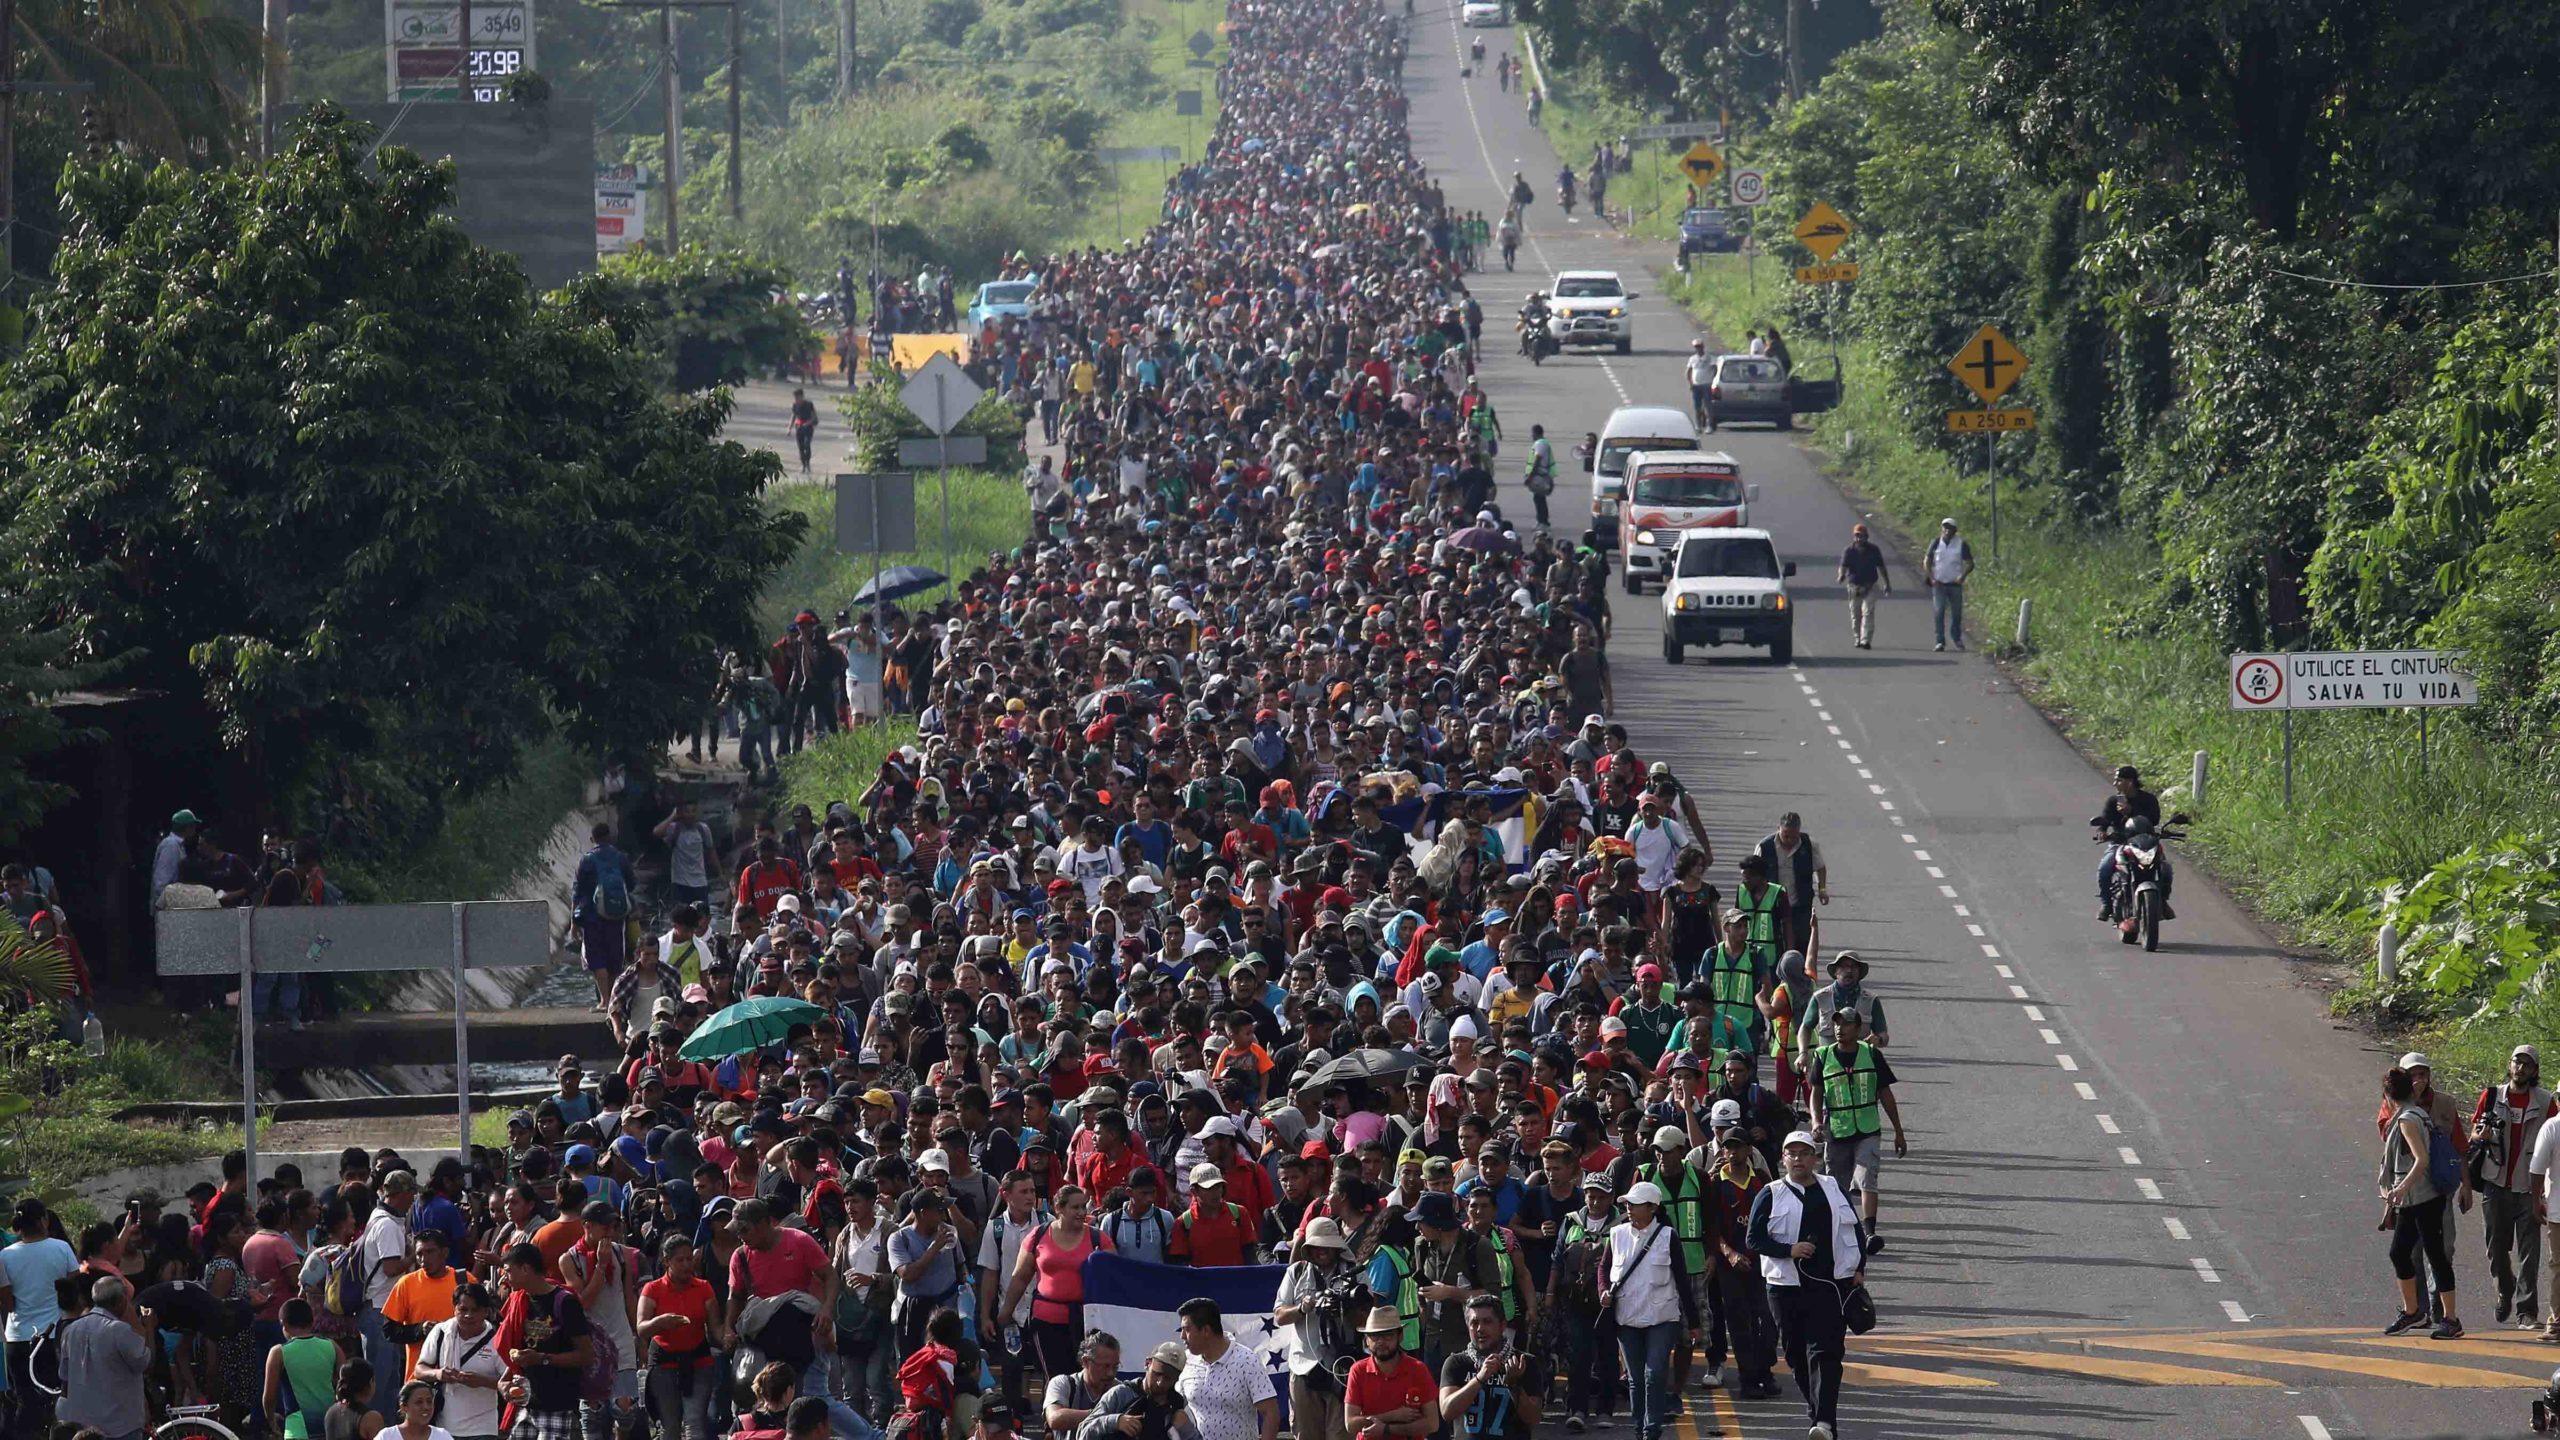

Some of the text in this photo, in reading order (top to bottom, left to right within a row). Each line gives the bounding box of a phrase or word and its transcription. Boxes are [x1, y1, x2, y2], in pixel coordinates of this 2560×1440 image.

[485, 15, 521, 32] 3549
[1740, 180, 1758, 192] 40
[606, 198, 628, 208] VISA
[1804, 270, 1811, 280] A
[1958, 413, 2026, 428] A 250 m
[2295, 657, 2473, 677] UTILICE EL CINTURO
[2307, 682, 2461, 701] SALVA TU VIDA
[754, 889, 765, 899] GO
